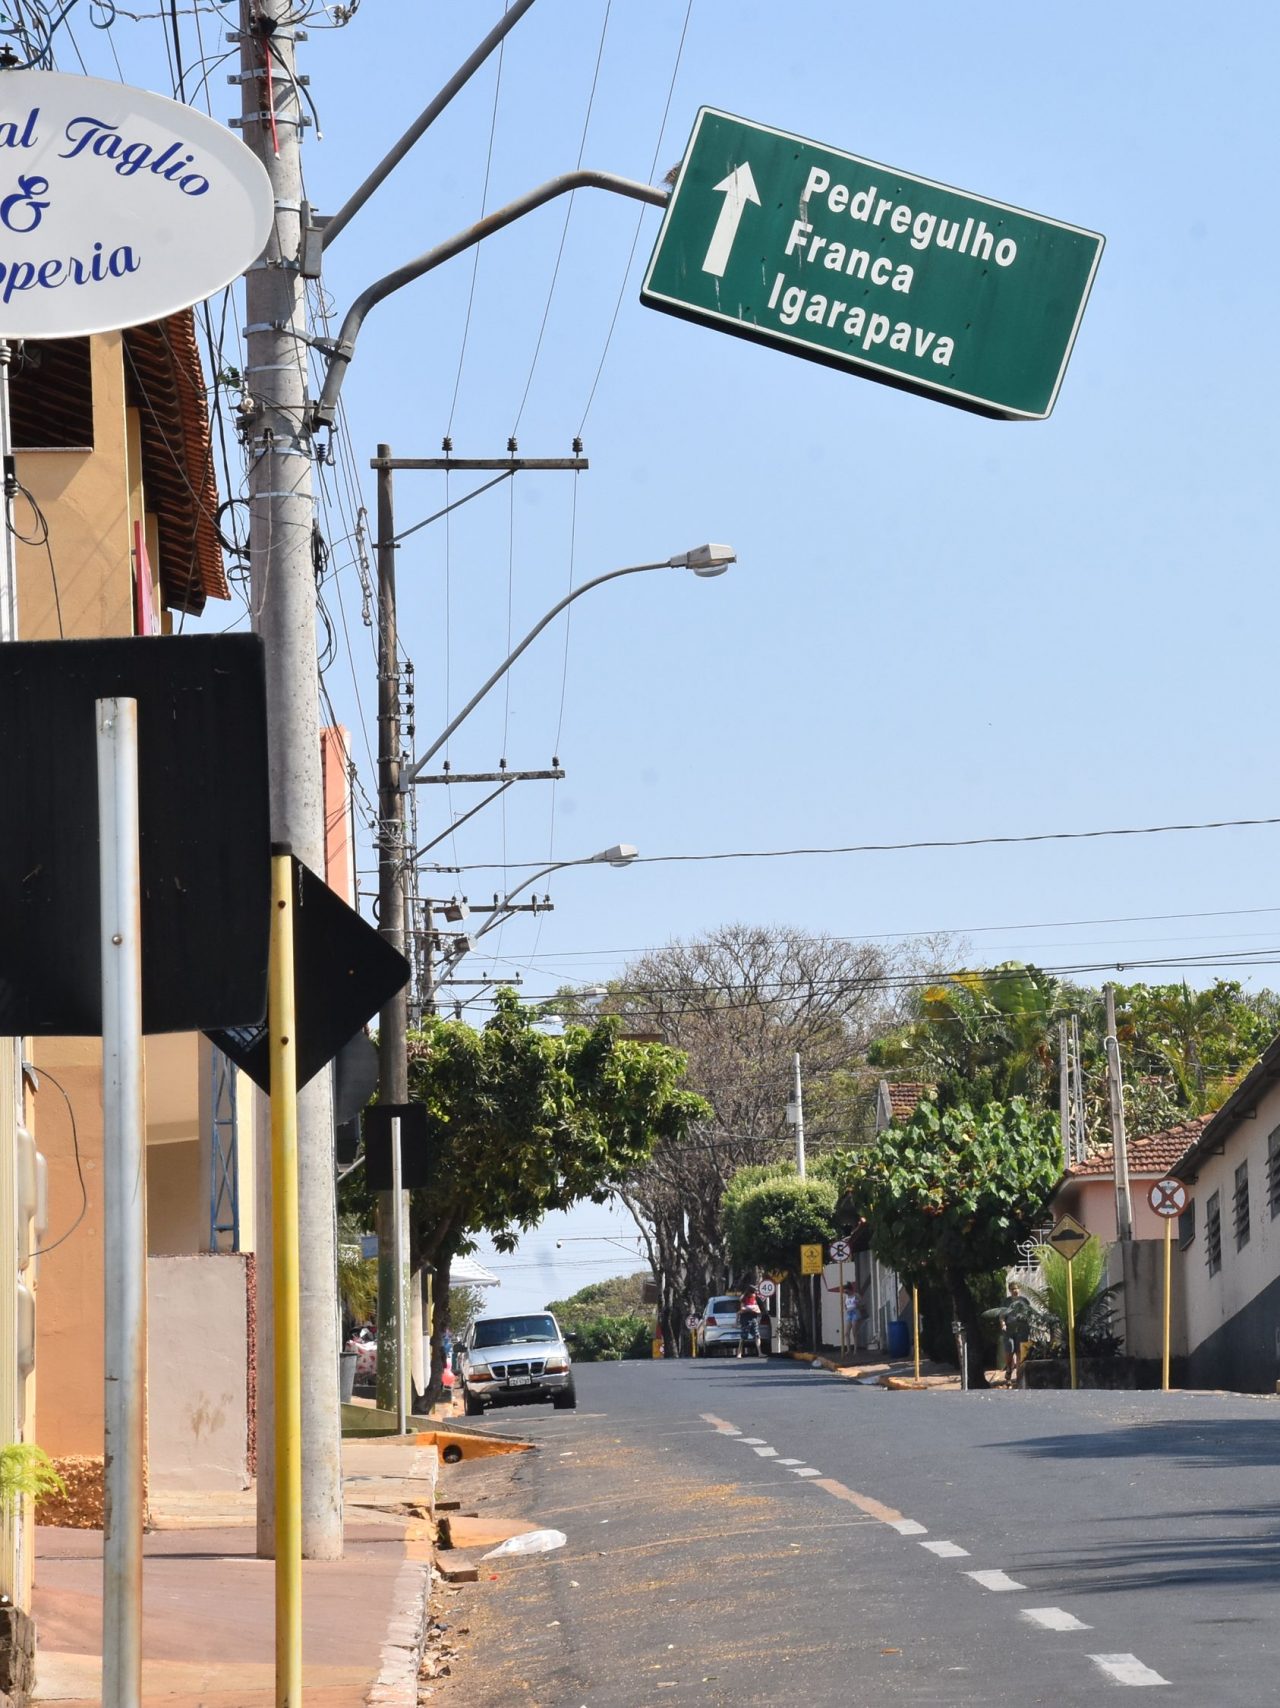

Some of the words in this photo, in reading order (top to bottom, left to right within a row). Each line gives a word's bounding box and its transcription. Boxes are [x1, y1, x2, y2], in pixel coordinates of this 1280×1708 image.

[58, 115, 211, 196] Taglio
[0, 174, 51, 233] &
[802, 166, 1018, 267] Pedregulho
[0, 242, 141, 305] peria
[785, 217, 915, 293] Franca
[768, 272, 955, 367] Igarapava
[762, 1284, 773, 1292] 40
